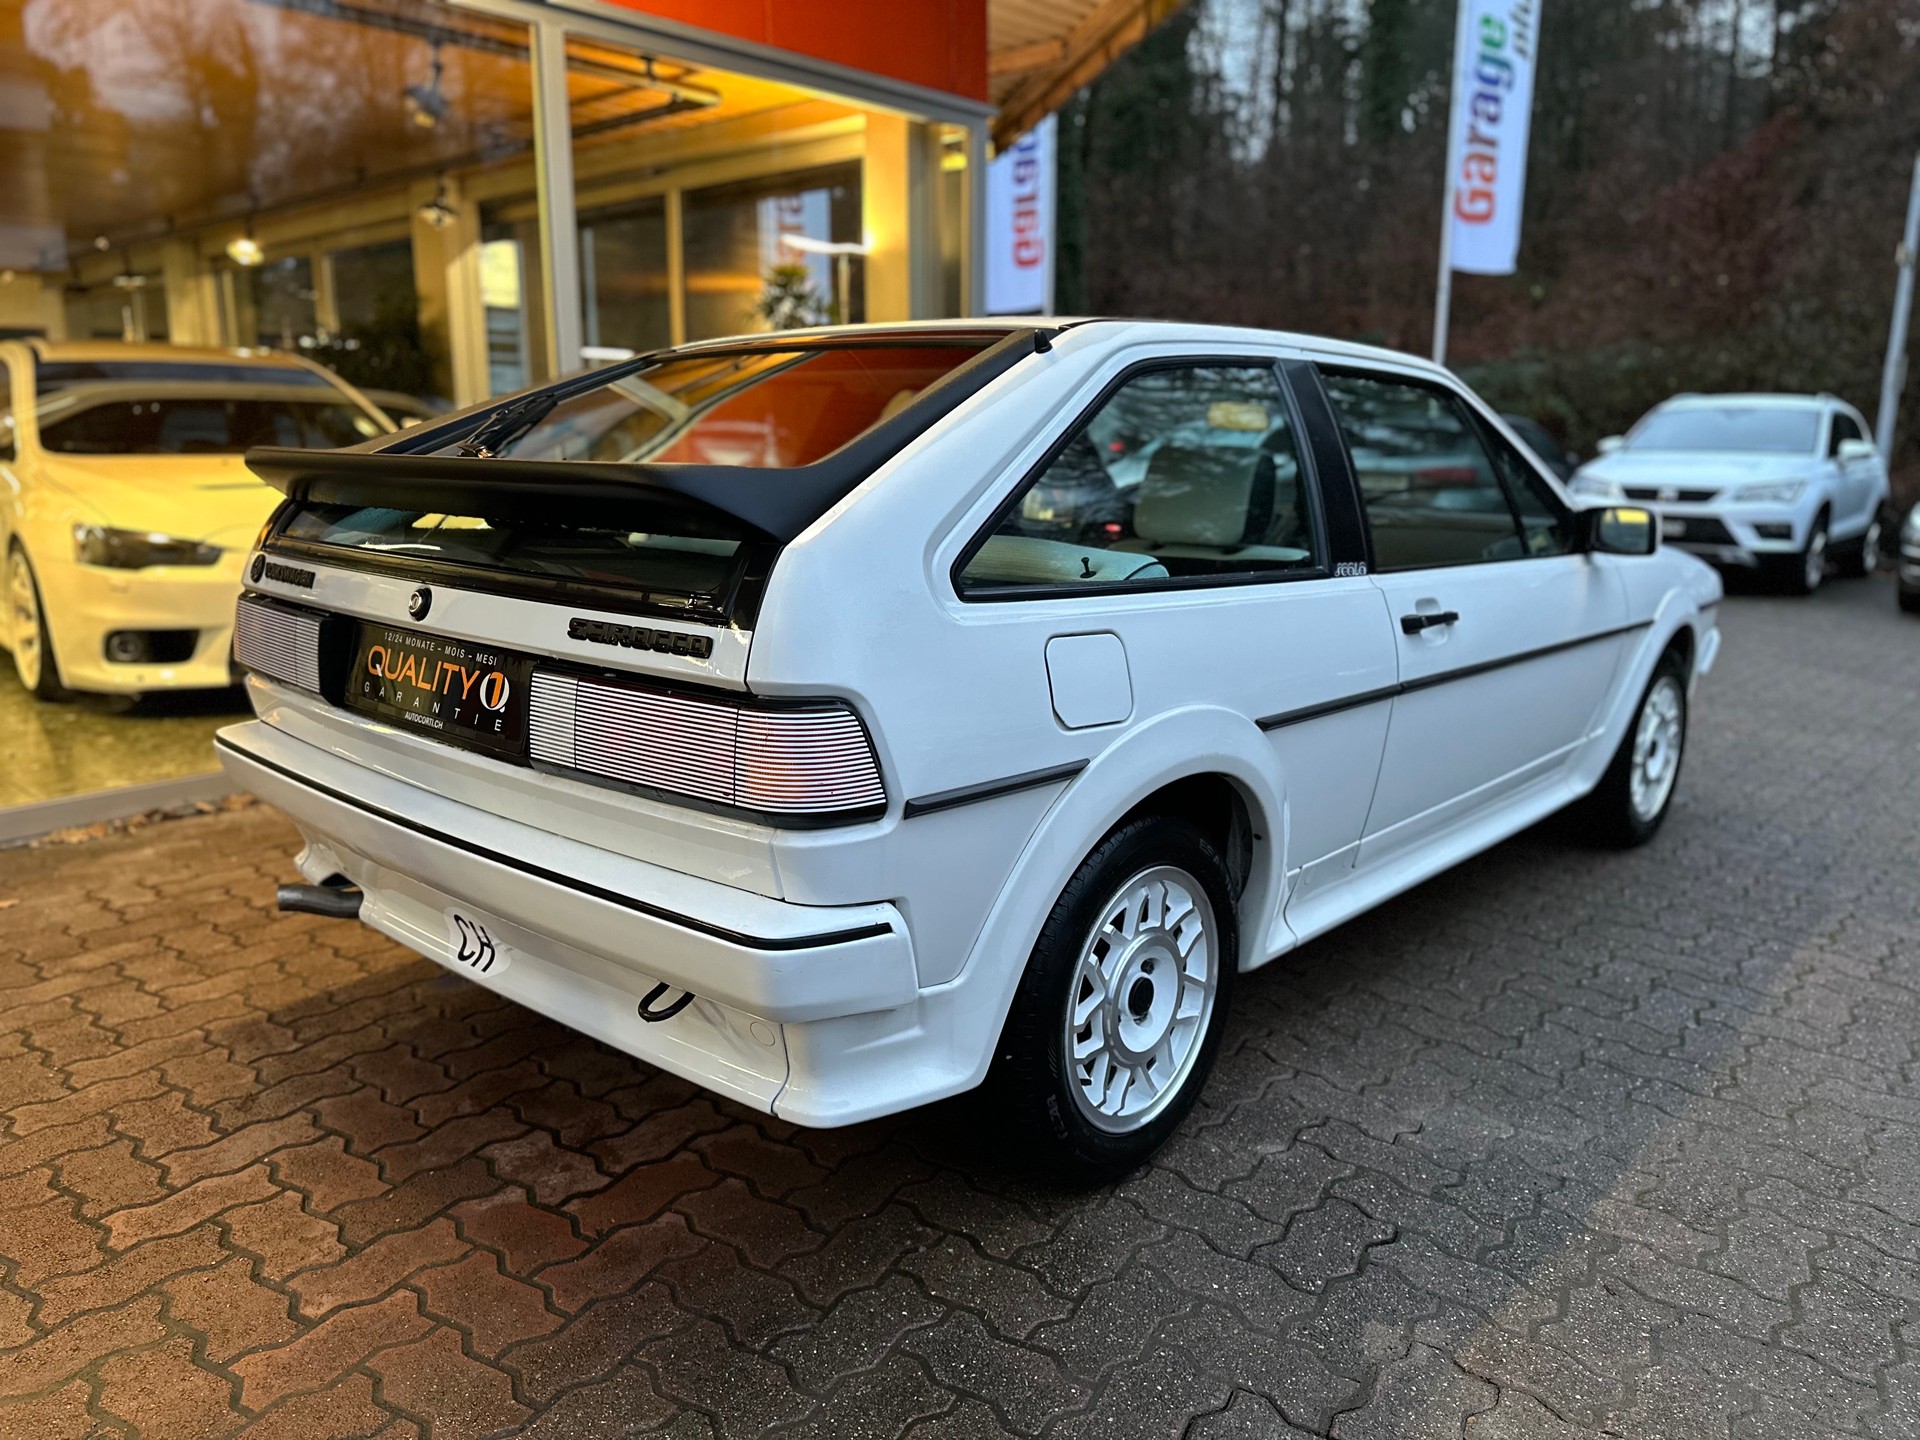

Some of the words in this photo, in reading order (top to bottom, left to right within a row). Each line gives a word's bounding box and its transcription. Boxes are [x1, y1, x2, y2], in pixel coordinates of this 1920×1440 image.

[1454, 14, 1515, 225] Garage
[384, 632, 403, 643] 12/24
[405, 636, 436, 652] MONATE
[444, 645, 466, 659] MOIS
[475, 652, 498, 666] MESI
[567, 617, 713, 659] SCIROCCO
[367, 645, 481, 700] QUALITY
[364, 681, 503, 732] GARANTIE
[404, 711, 444, 730] AUTOCORTI.CH
[453, 914, 496, 973] CH
